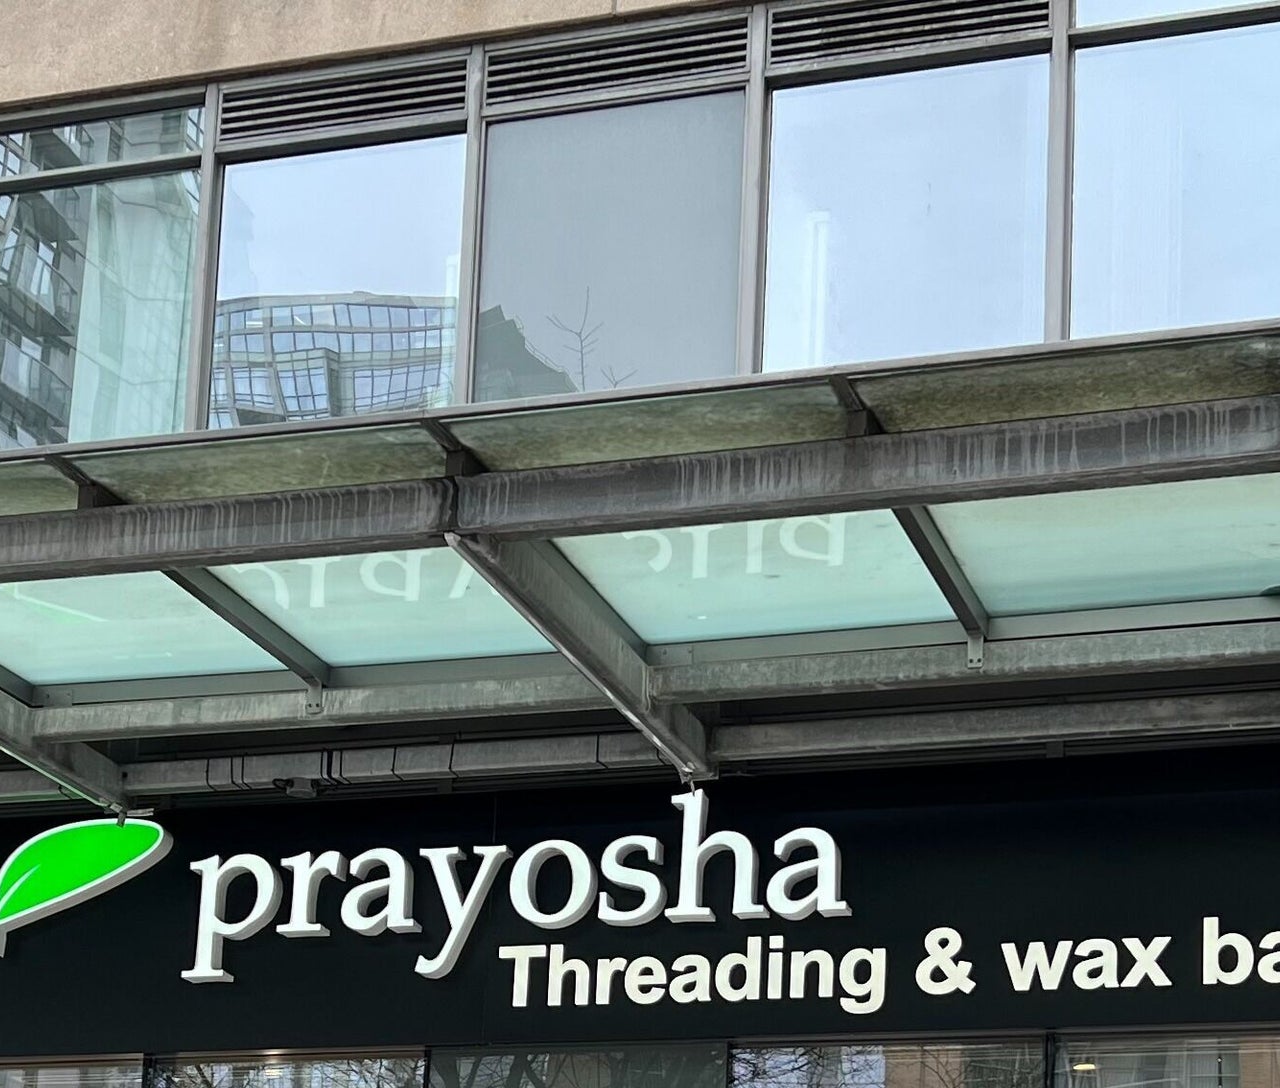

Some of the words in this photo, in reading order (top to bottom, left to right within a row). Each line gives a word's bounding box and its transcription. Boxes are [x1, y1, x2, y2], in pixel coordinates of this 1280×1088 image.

[181, 788, 852, 983] prayosha
[498, 935, 887, 1014] Threading
[915, 927, 976, 995] &
[1001, 936, 1172, 991] wax
